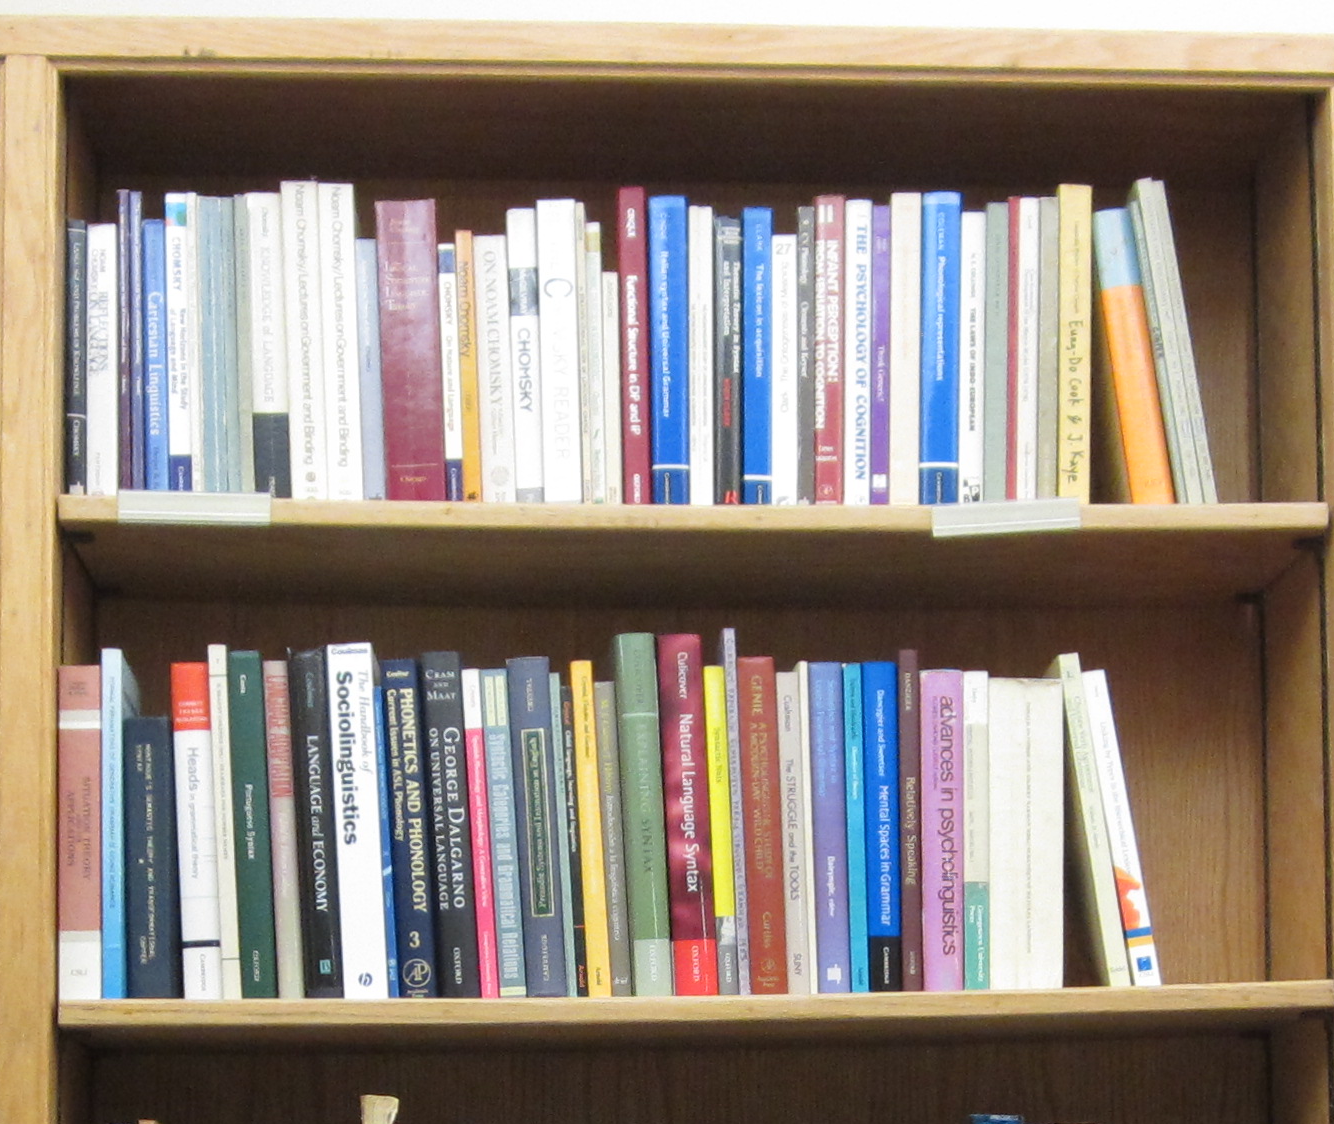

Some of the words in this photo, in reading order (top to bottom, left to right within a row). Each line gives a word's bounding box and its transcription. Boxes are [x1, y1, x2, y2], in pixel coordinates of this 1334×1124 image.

[856, 225, 868, 255] THE
[148, 291, 163, 358] Cartesian
[854, 264, 868, 364] PSYCHOLOGY
[146, 363, 163, 436] Linguistics
[516, 328, 533, 413] CHOMSKY
[855, 369, 868, 388] OF
[854, 395, 867, 480] COGNITION
[335, 671, 360, 846] Sociolinguistics
[399, 687, 417, 775] PHONETICS
[429, 728, 440, 747] ON
[442, 727, 460, 802] GEORGE
[678, 714, 696, 767] Natural
[938, 696, 958, 783] advances
[307, 735, 324, 814] LANGUAGE
[405, 779, 420, 815] AND
[431, 751, 446, 831] UNIVERSAL
[679, 771, 698, 839] Language
[941, 787, 957, 801] in
[311, 816, 324, 837] and
[446, 806, 464, 909] DALGARNO
[312, 840, 327, 913] ECONOMY
[408, 818, 427, 913] PHONOLOGY
[436, 834, 449, 911] LANGUAGE
[683, 843, 700, 892] Syntax
[937, 807, 959, 956] psycholinguistics
